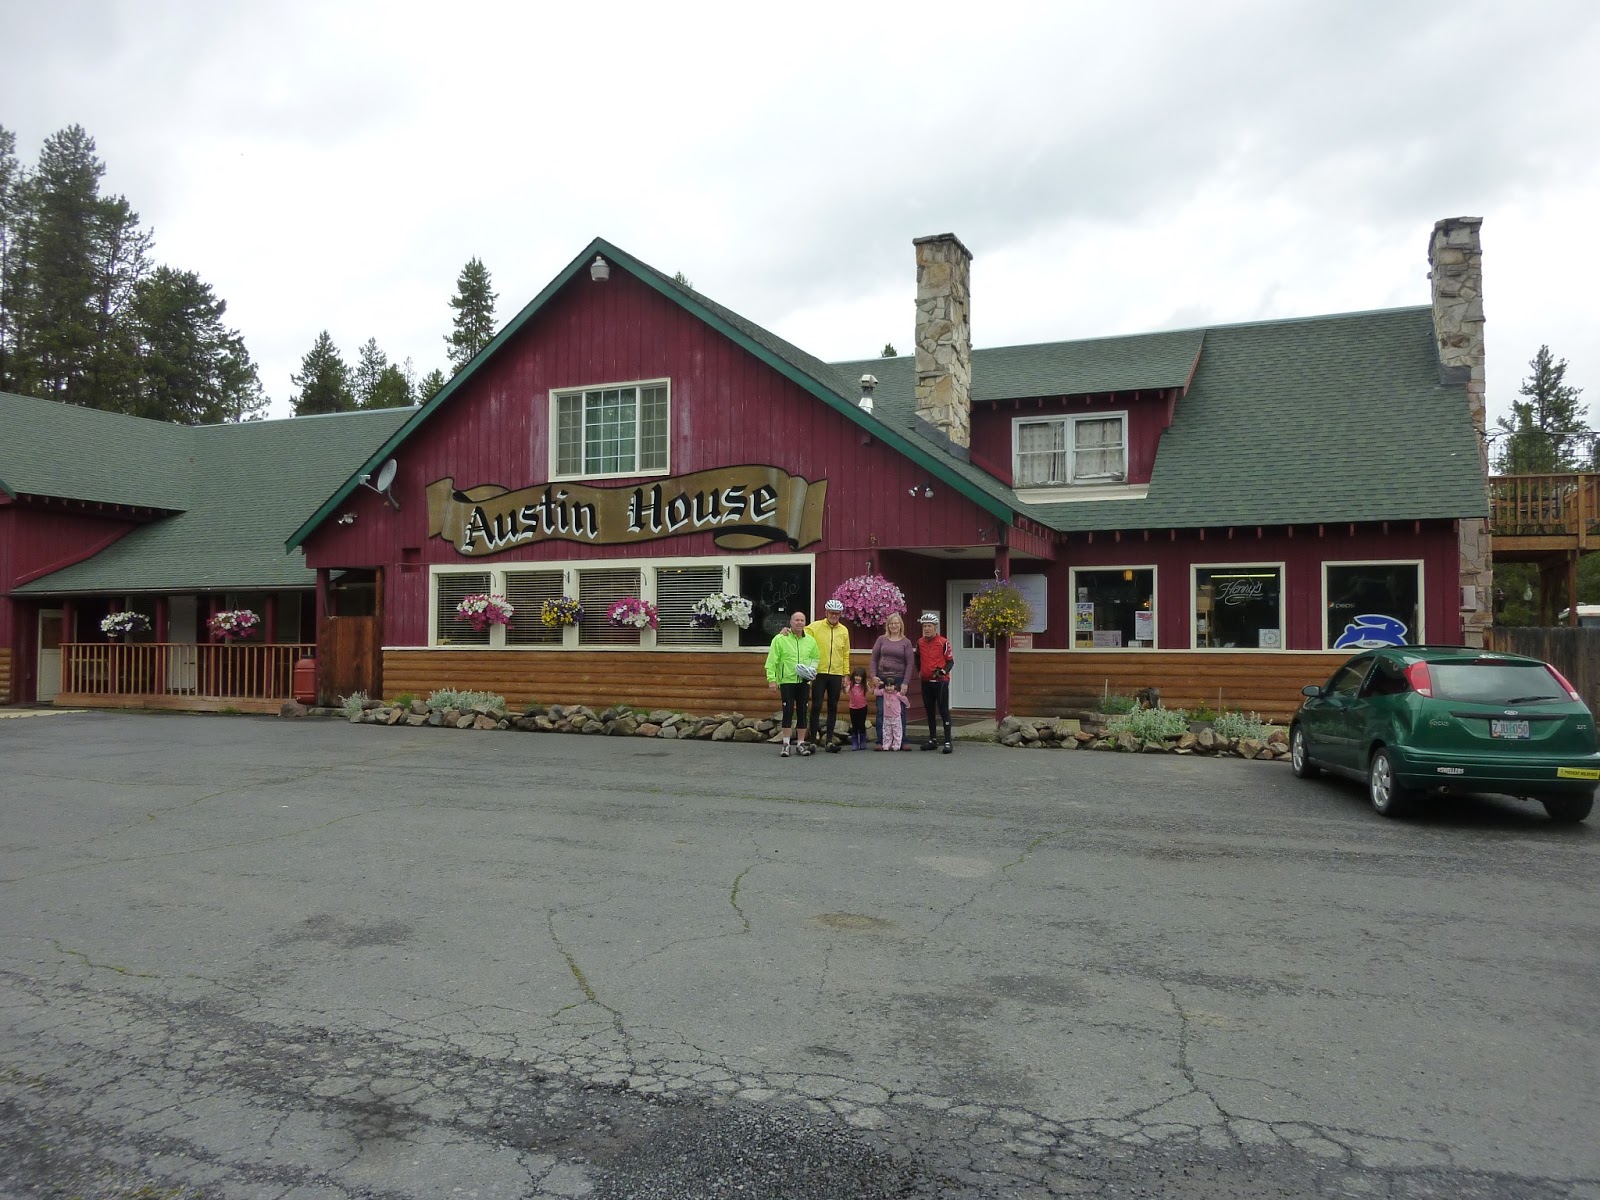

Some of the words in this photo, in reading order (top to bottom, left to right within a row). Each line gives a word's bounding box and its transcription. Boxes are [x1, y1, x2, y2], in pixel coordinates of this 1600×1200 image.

[461, 485, 599, 552] Austin
[627, 483, 778, 533] House
[1215, 579, 1264, 600] Henry's
[1492, 723, 1508, 734] ZJU
[1513, 723, 1528, 735] 050
